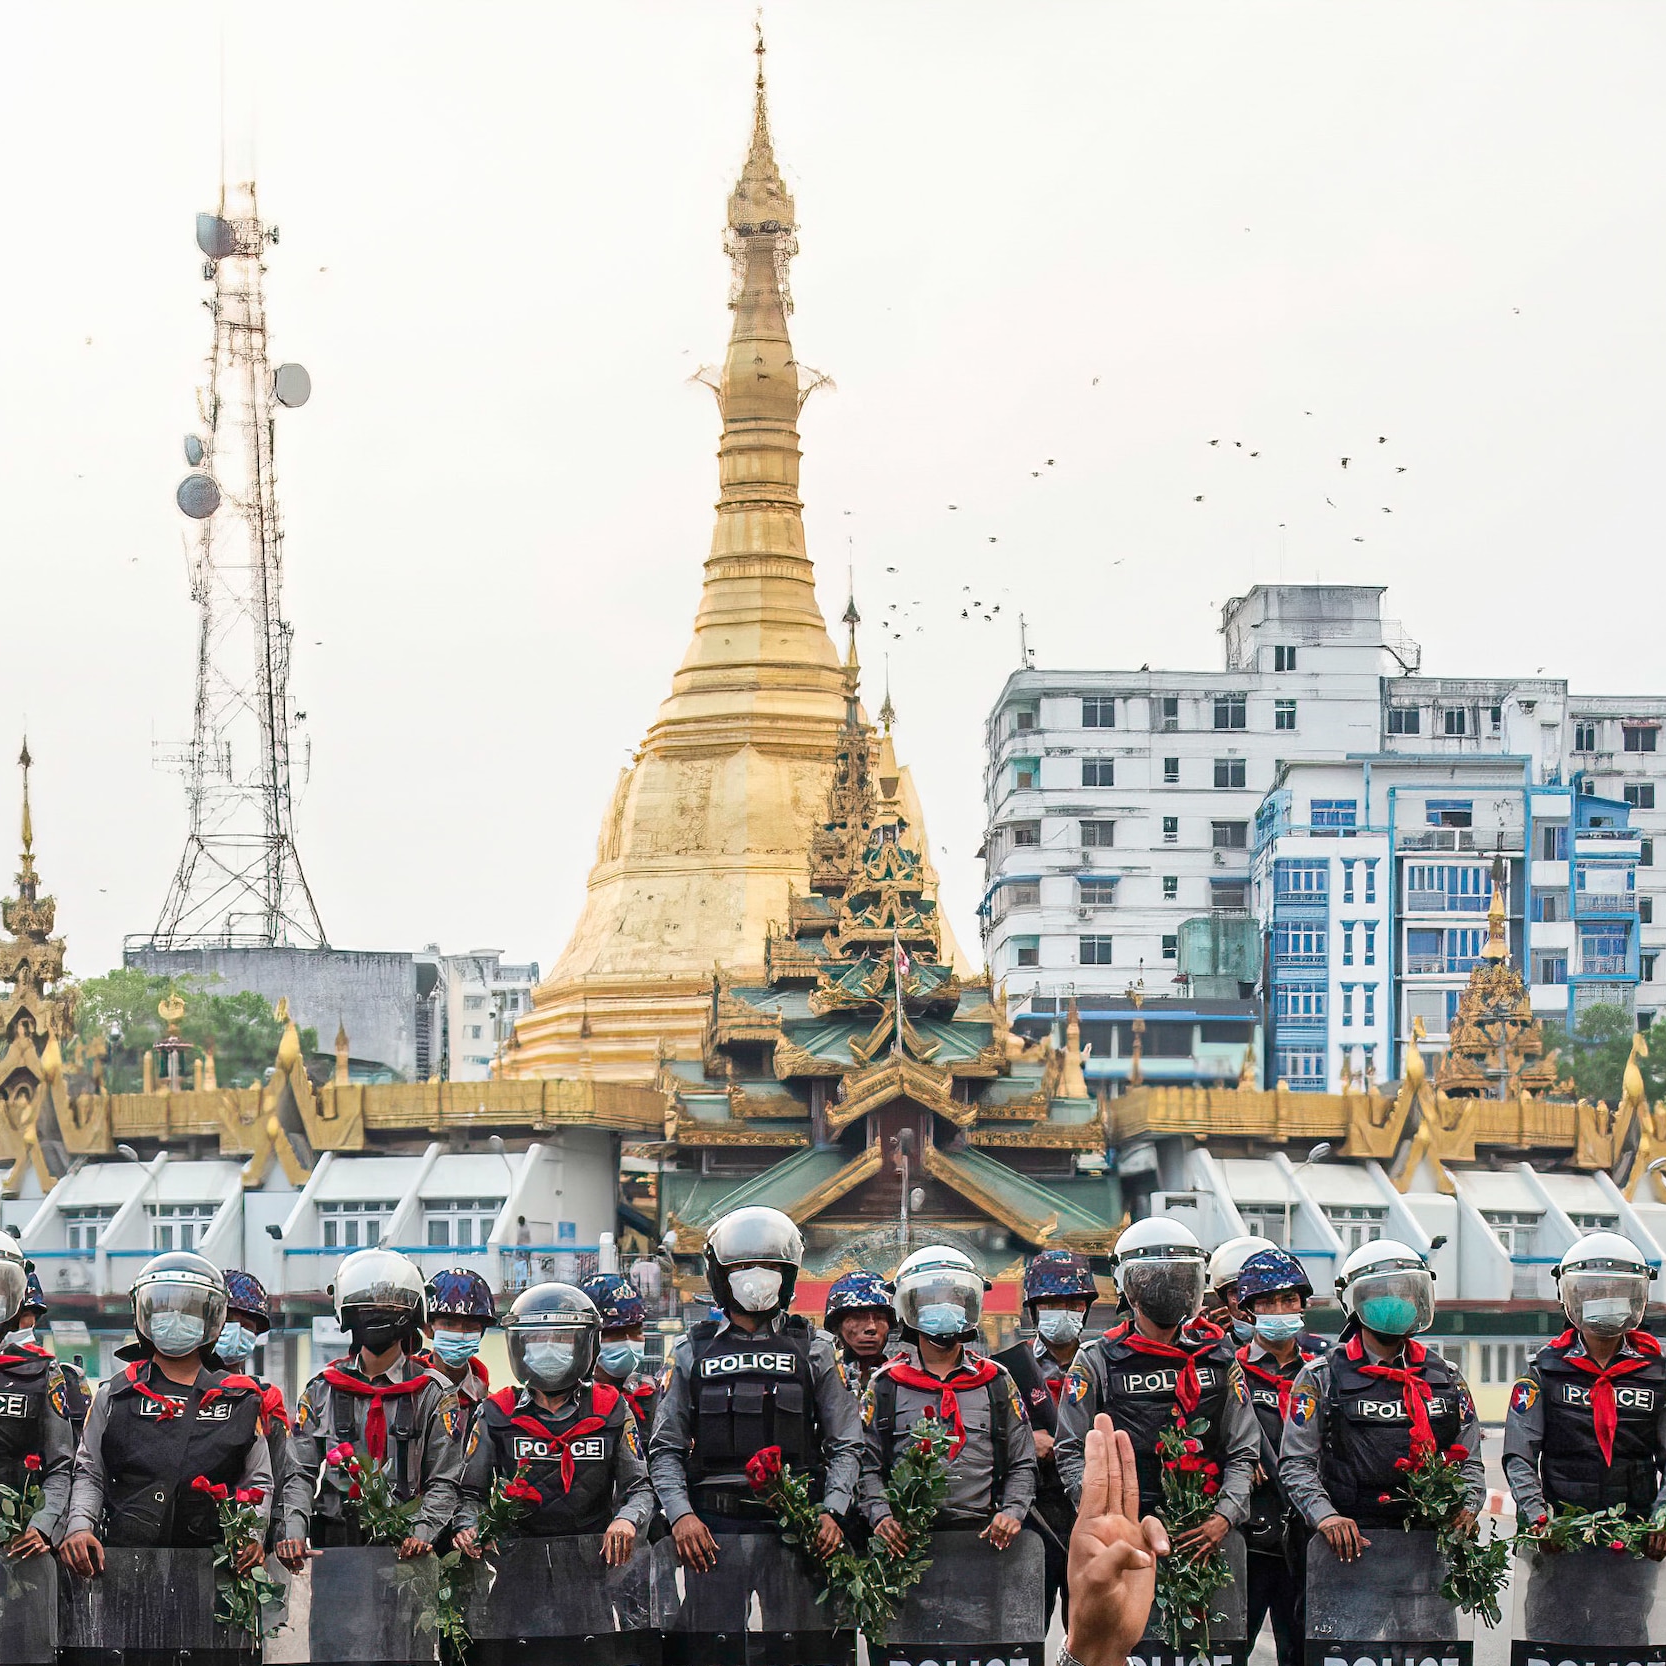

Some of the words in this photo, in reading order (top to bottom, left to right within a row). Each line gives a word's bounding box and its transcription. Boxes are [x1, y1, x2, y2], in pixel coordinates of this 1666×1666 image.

[705, 1354, 791, 1376] POLICE
[1129, 1370, 1212, 1391] POLE
[1363, 1399, 1443, 1419] POLE
[519, 1441, 601, 1457] POCE
